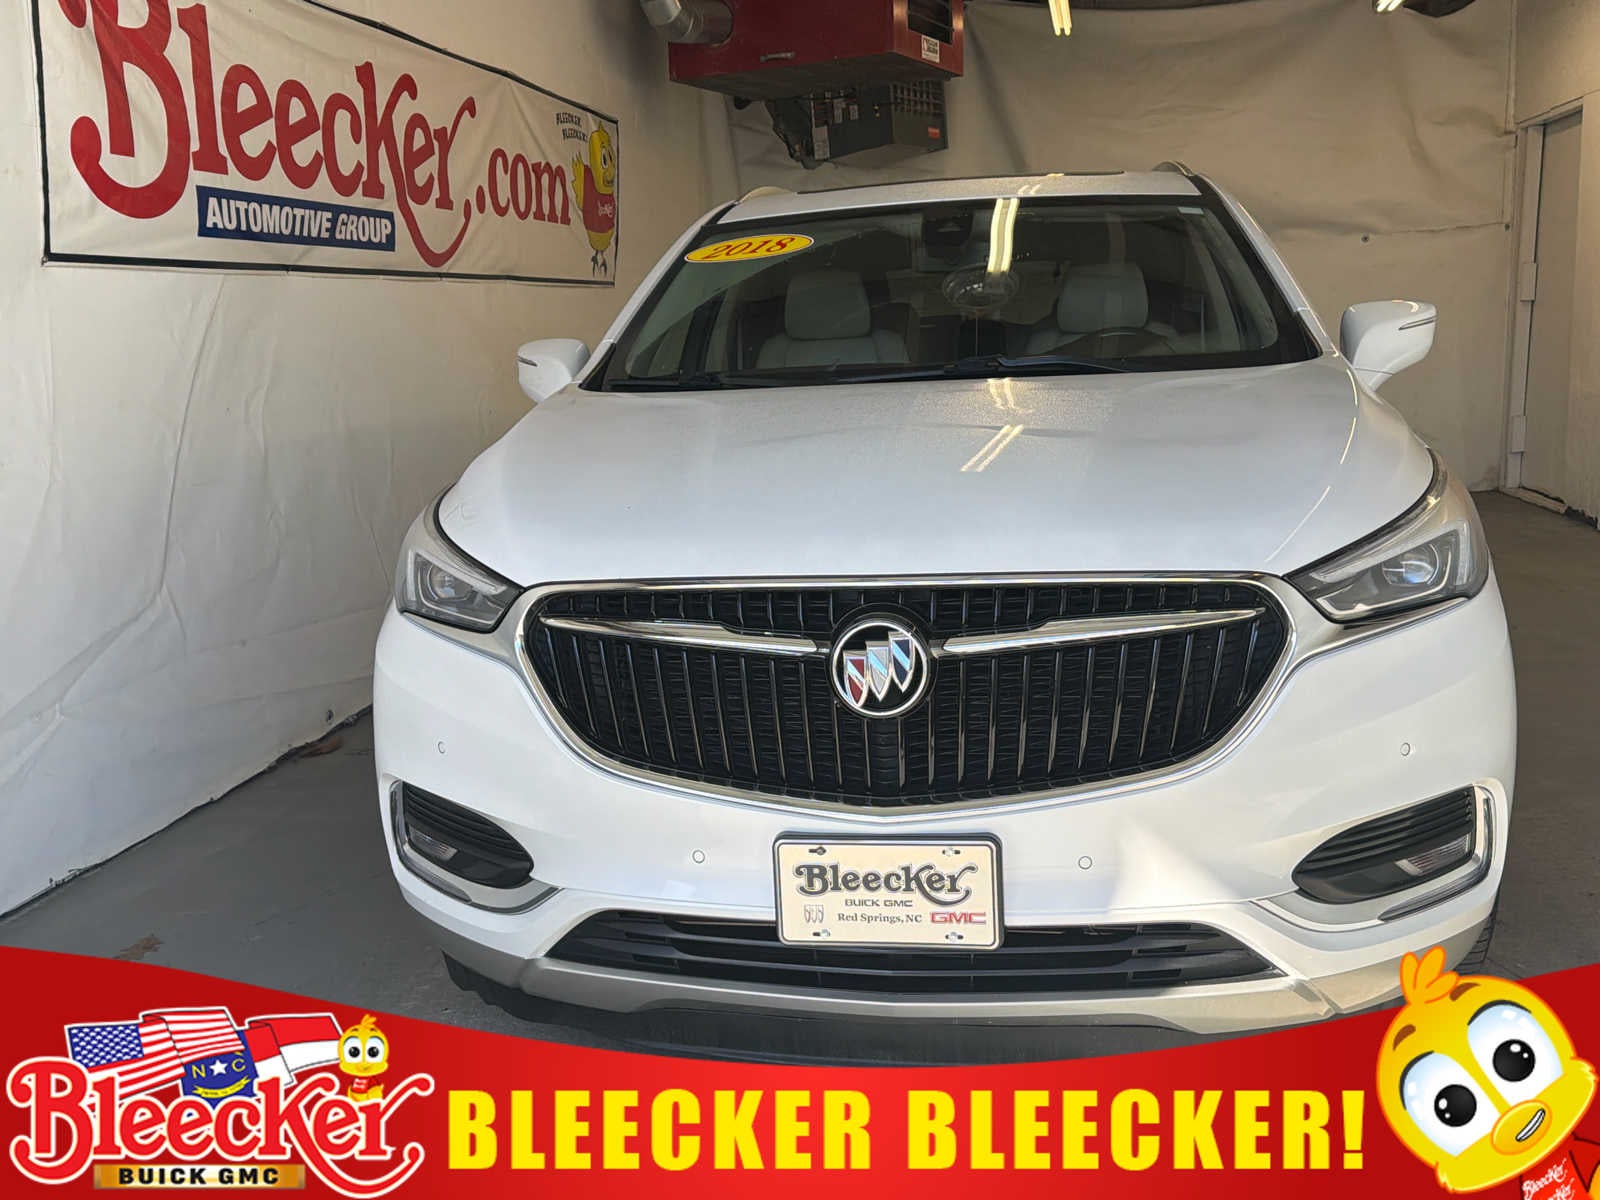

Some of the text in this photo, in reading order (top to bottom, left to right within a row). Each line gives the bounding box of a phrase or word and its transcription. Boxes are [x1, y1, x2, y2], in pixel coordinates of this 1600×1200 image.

[206, 197, 392, 244] AUTOMOTIVE GROUP
[701, 237, 795, 260] 2018
[794, 862, 978, 906] Bleecker
[845, 899, 913, 907] BUICK GMC
[838, 913, 922, 925] Red Springs, NC
[930, 912, 986, 925] GMC
